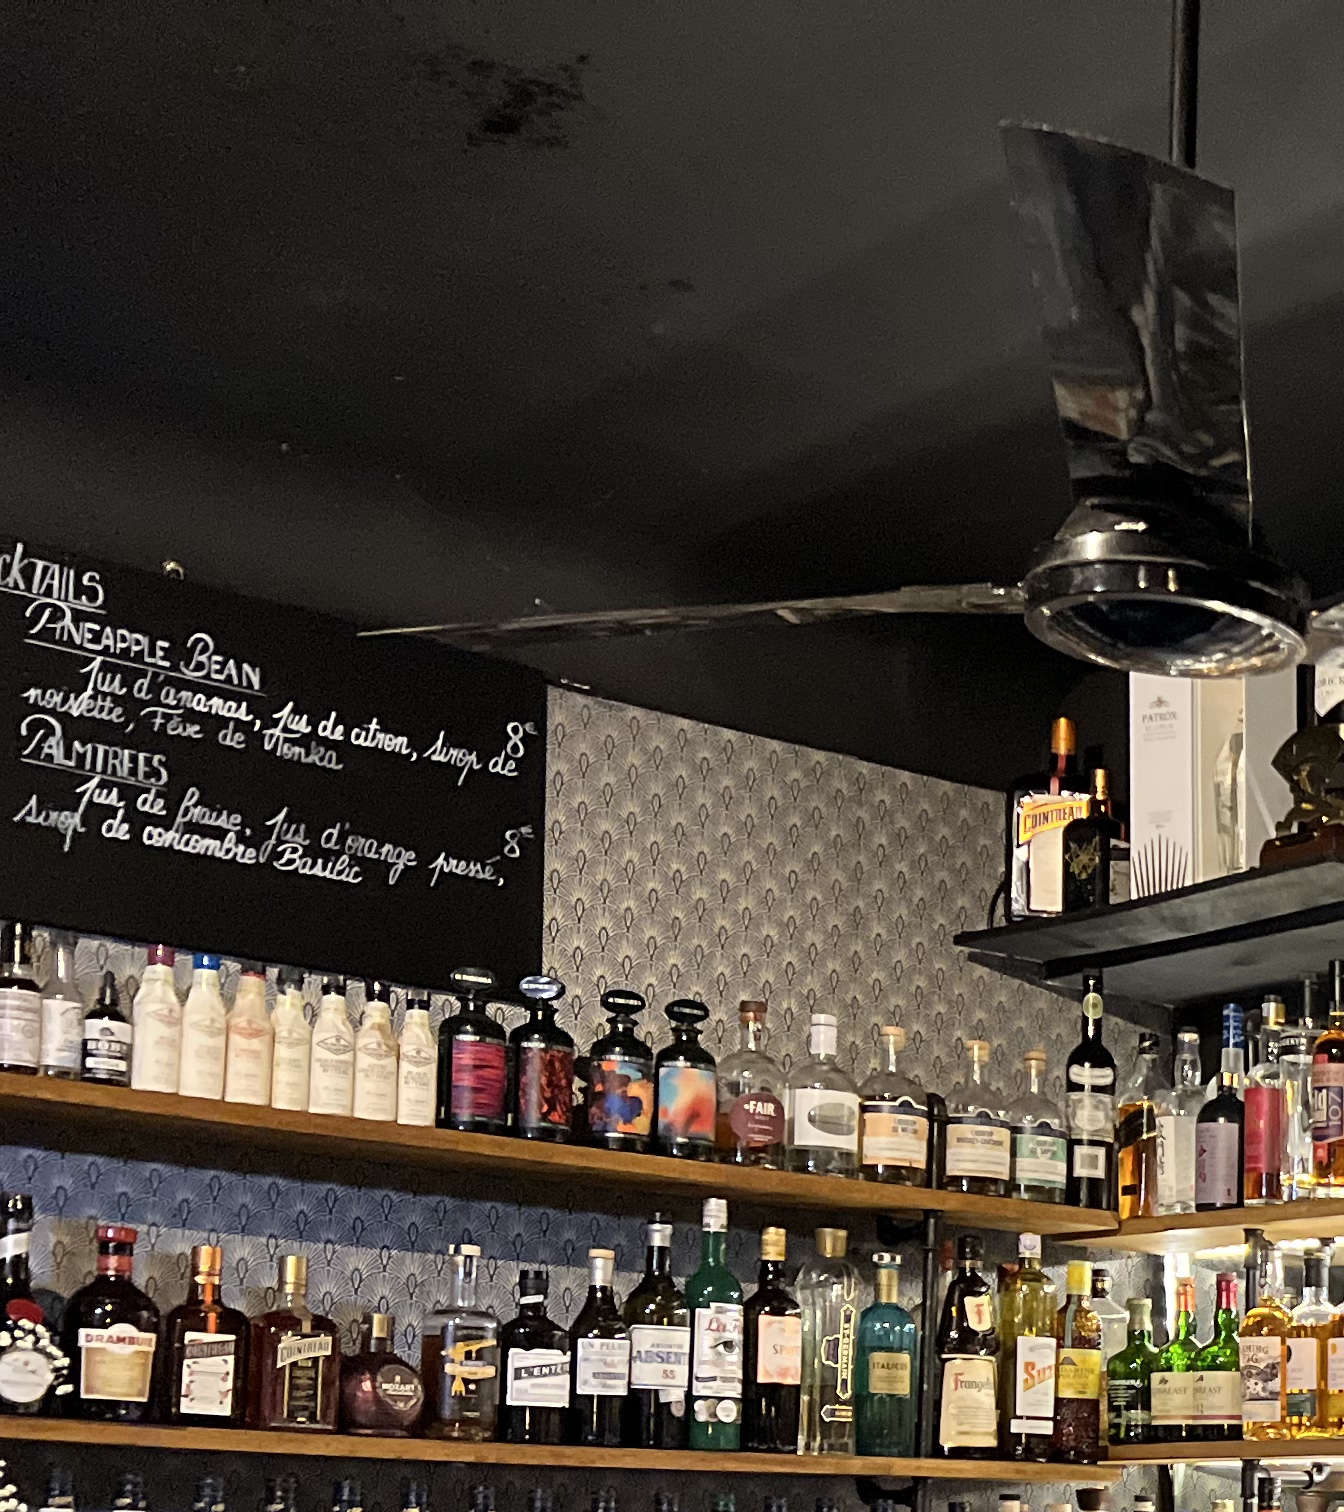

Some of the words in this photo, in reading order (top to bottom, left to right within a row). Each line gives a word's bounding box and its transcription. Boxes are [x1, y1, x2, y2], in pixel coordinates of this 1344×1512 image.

[25, 600, 170, 667] PINEAPPLE
[180, 633, 261, 690] BEAN
[20, 714, 168, 785] PALMTREES
[134, 671, 261, 731] d'ananas,
[318, 711, 344, 740] de
[351, 717, 417, 762] citron,
[488, 751, 518, 776] de
[141, 708, 203, 738] Fève
[218, 721, 245, 748] de
[102, 809, 130, 840] de
[142, 824, 257, 863] concombre
[273, 843, 363, 883] Basilic
[137, 789, 166, 815] de
[321, 822, 417, 885] d'orange
[428, 852, 504, 887] pressé,
